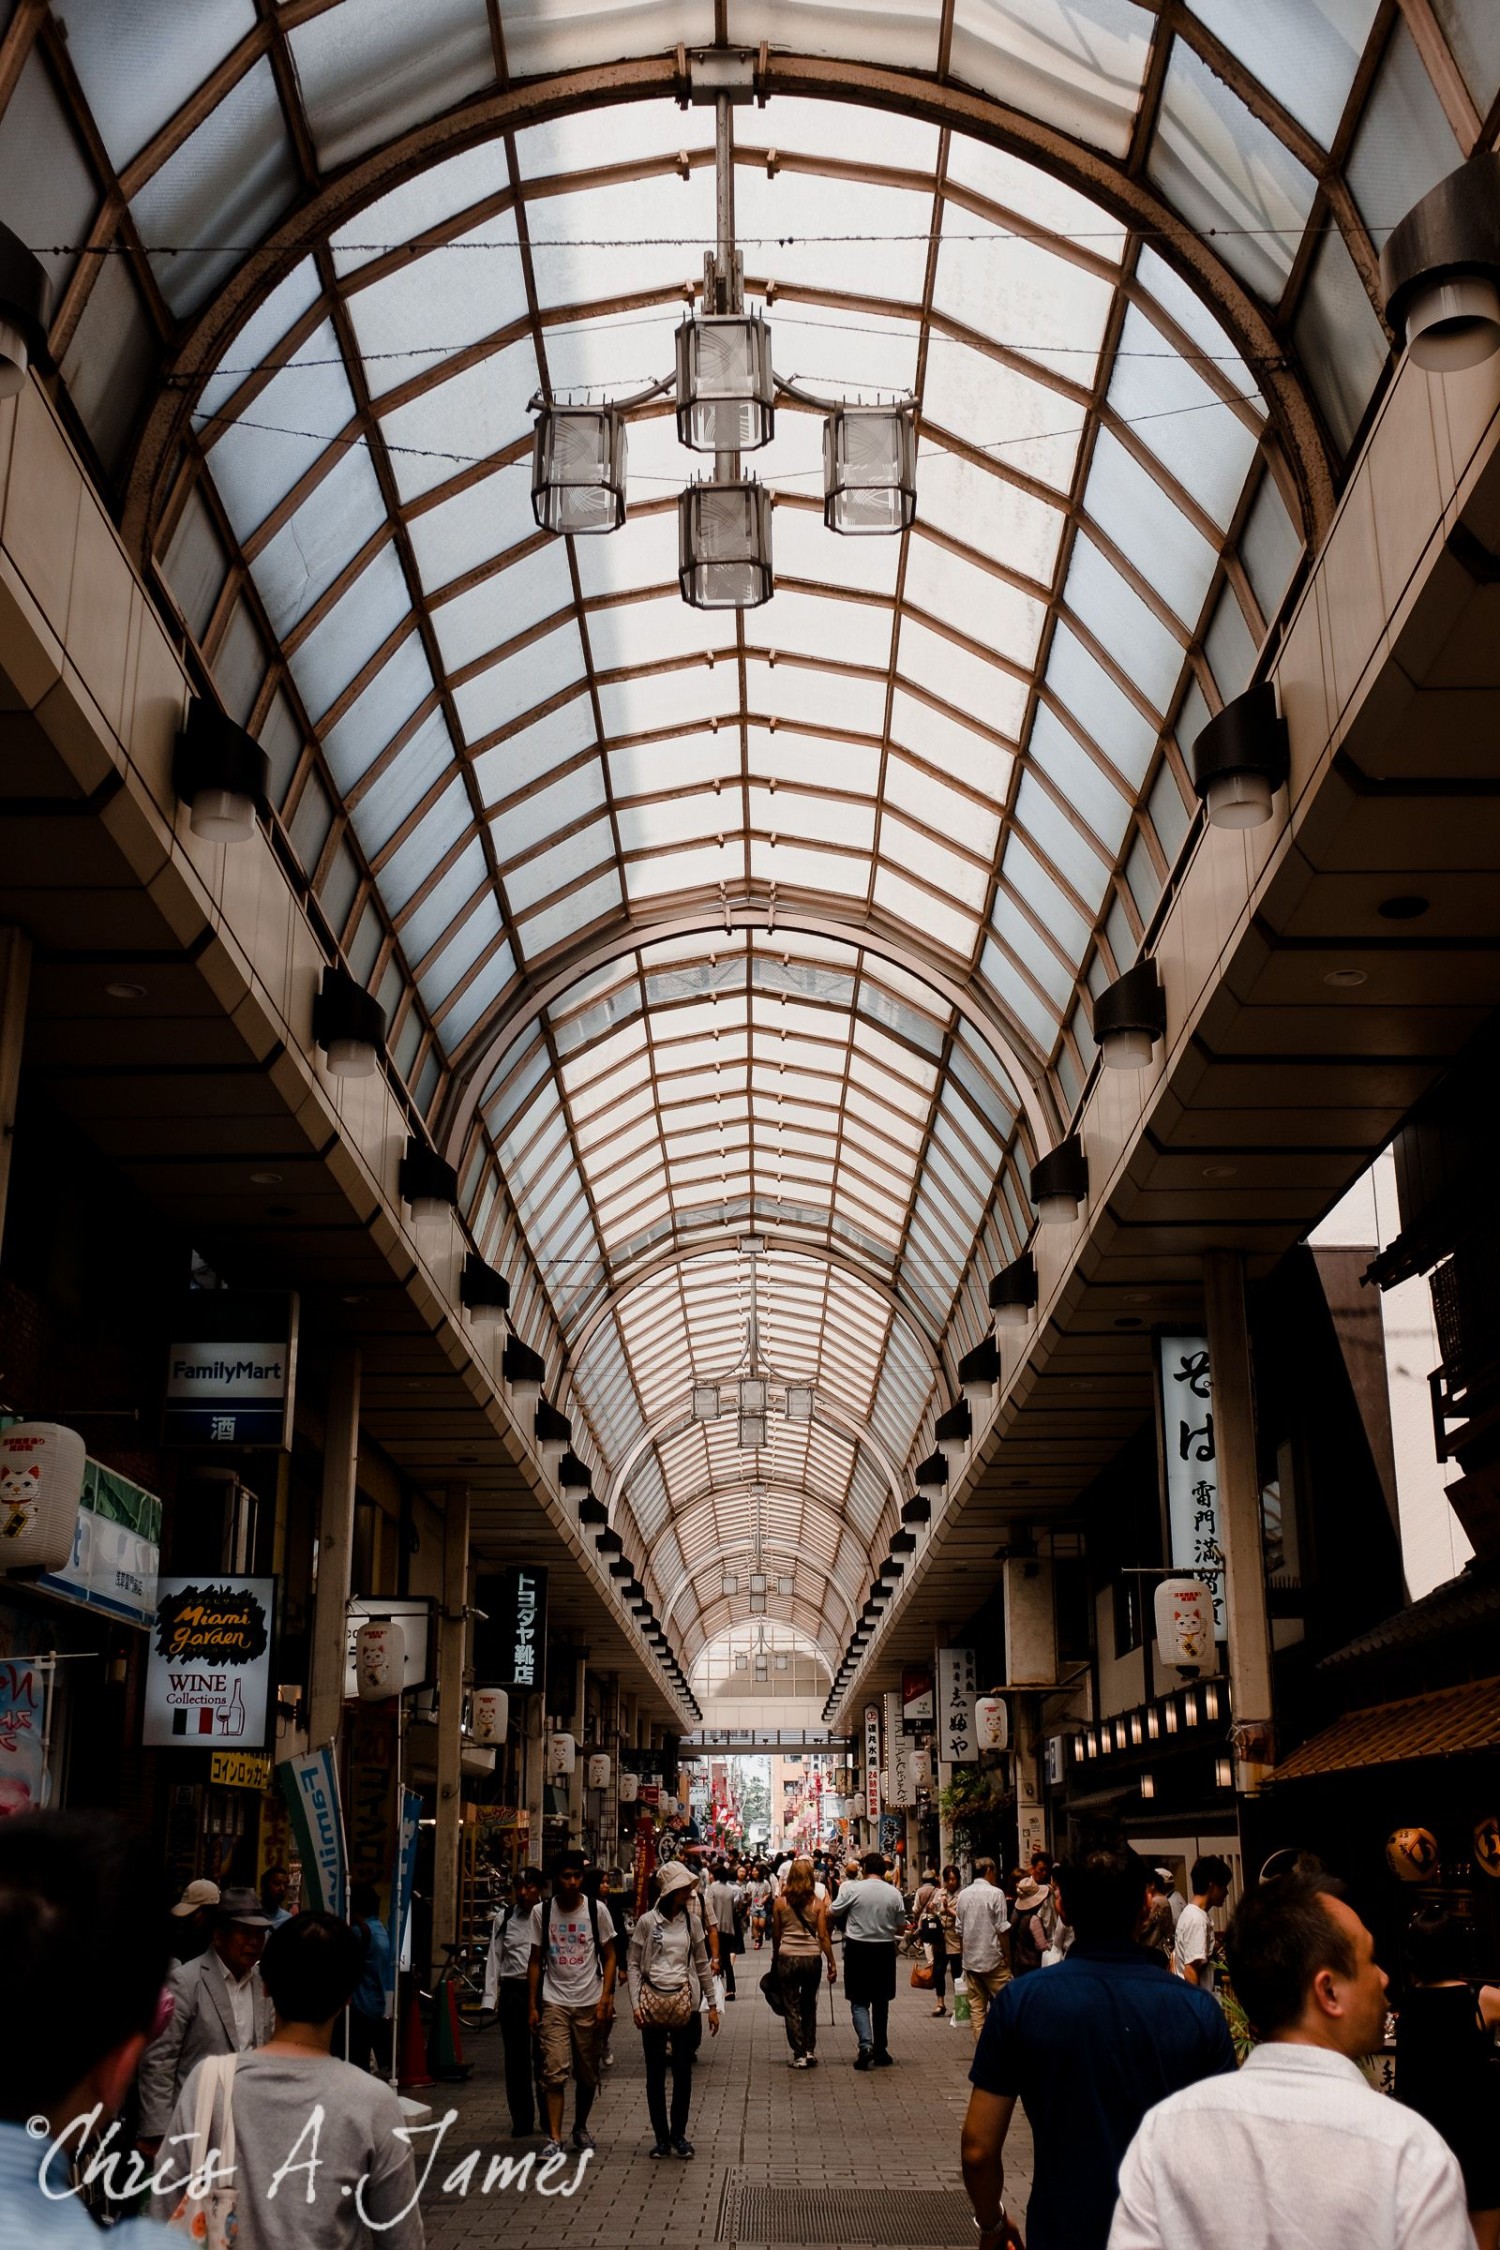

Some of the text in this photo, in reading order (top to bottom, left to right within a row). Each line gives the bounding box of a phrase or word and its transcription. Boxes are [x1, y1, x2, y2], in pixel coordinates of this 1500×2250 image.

[173, 1361, 281, 1384] FamilyMart
[210, 1415, 237, 1441] 酒
[173, 1605, 251, 1626] Miami
[513, 1573, 536, 1686] トヨダヤ靴店
[168, 1674, 227, 1692] WINE
[166, 1692, 227, 1705] Collections
